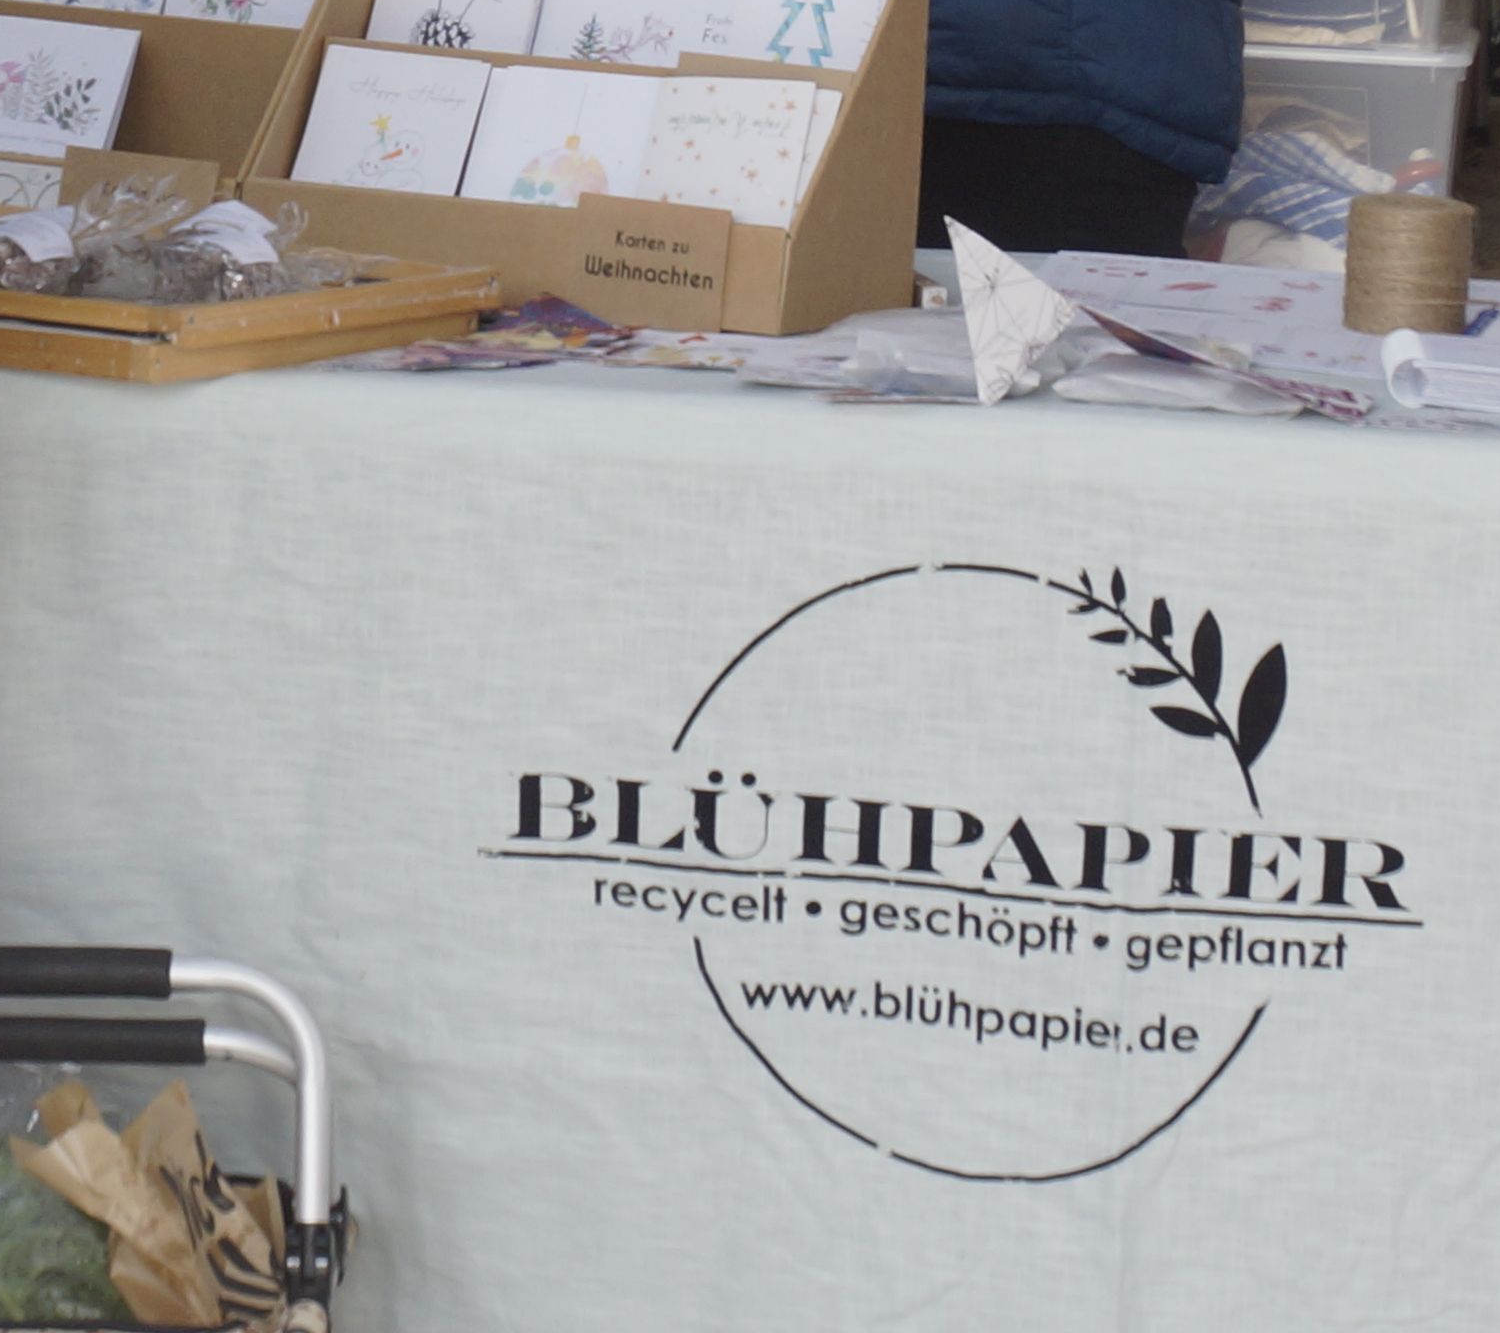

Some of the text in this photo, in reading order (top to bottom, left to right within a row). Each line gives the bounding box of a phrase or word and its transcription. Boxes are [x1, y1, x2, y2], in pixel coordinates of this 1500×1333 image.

[584, 255, 714, 290] Weihnachten
[615, 231, 690, 254] Karten zu
[507, 768, 1412, 913] BLÜHPAPIER
[592, 873, 1349, 974] recycelt geschöpft gepflanzt
[740, 975, 1202, 1056] www.blühpapier.de
